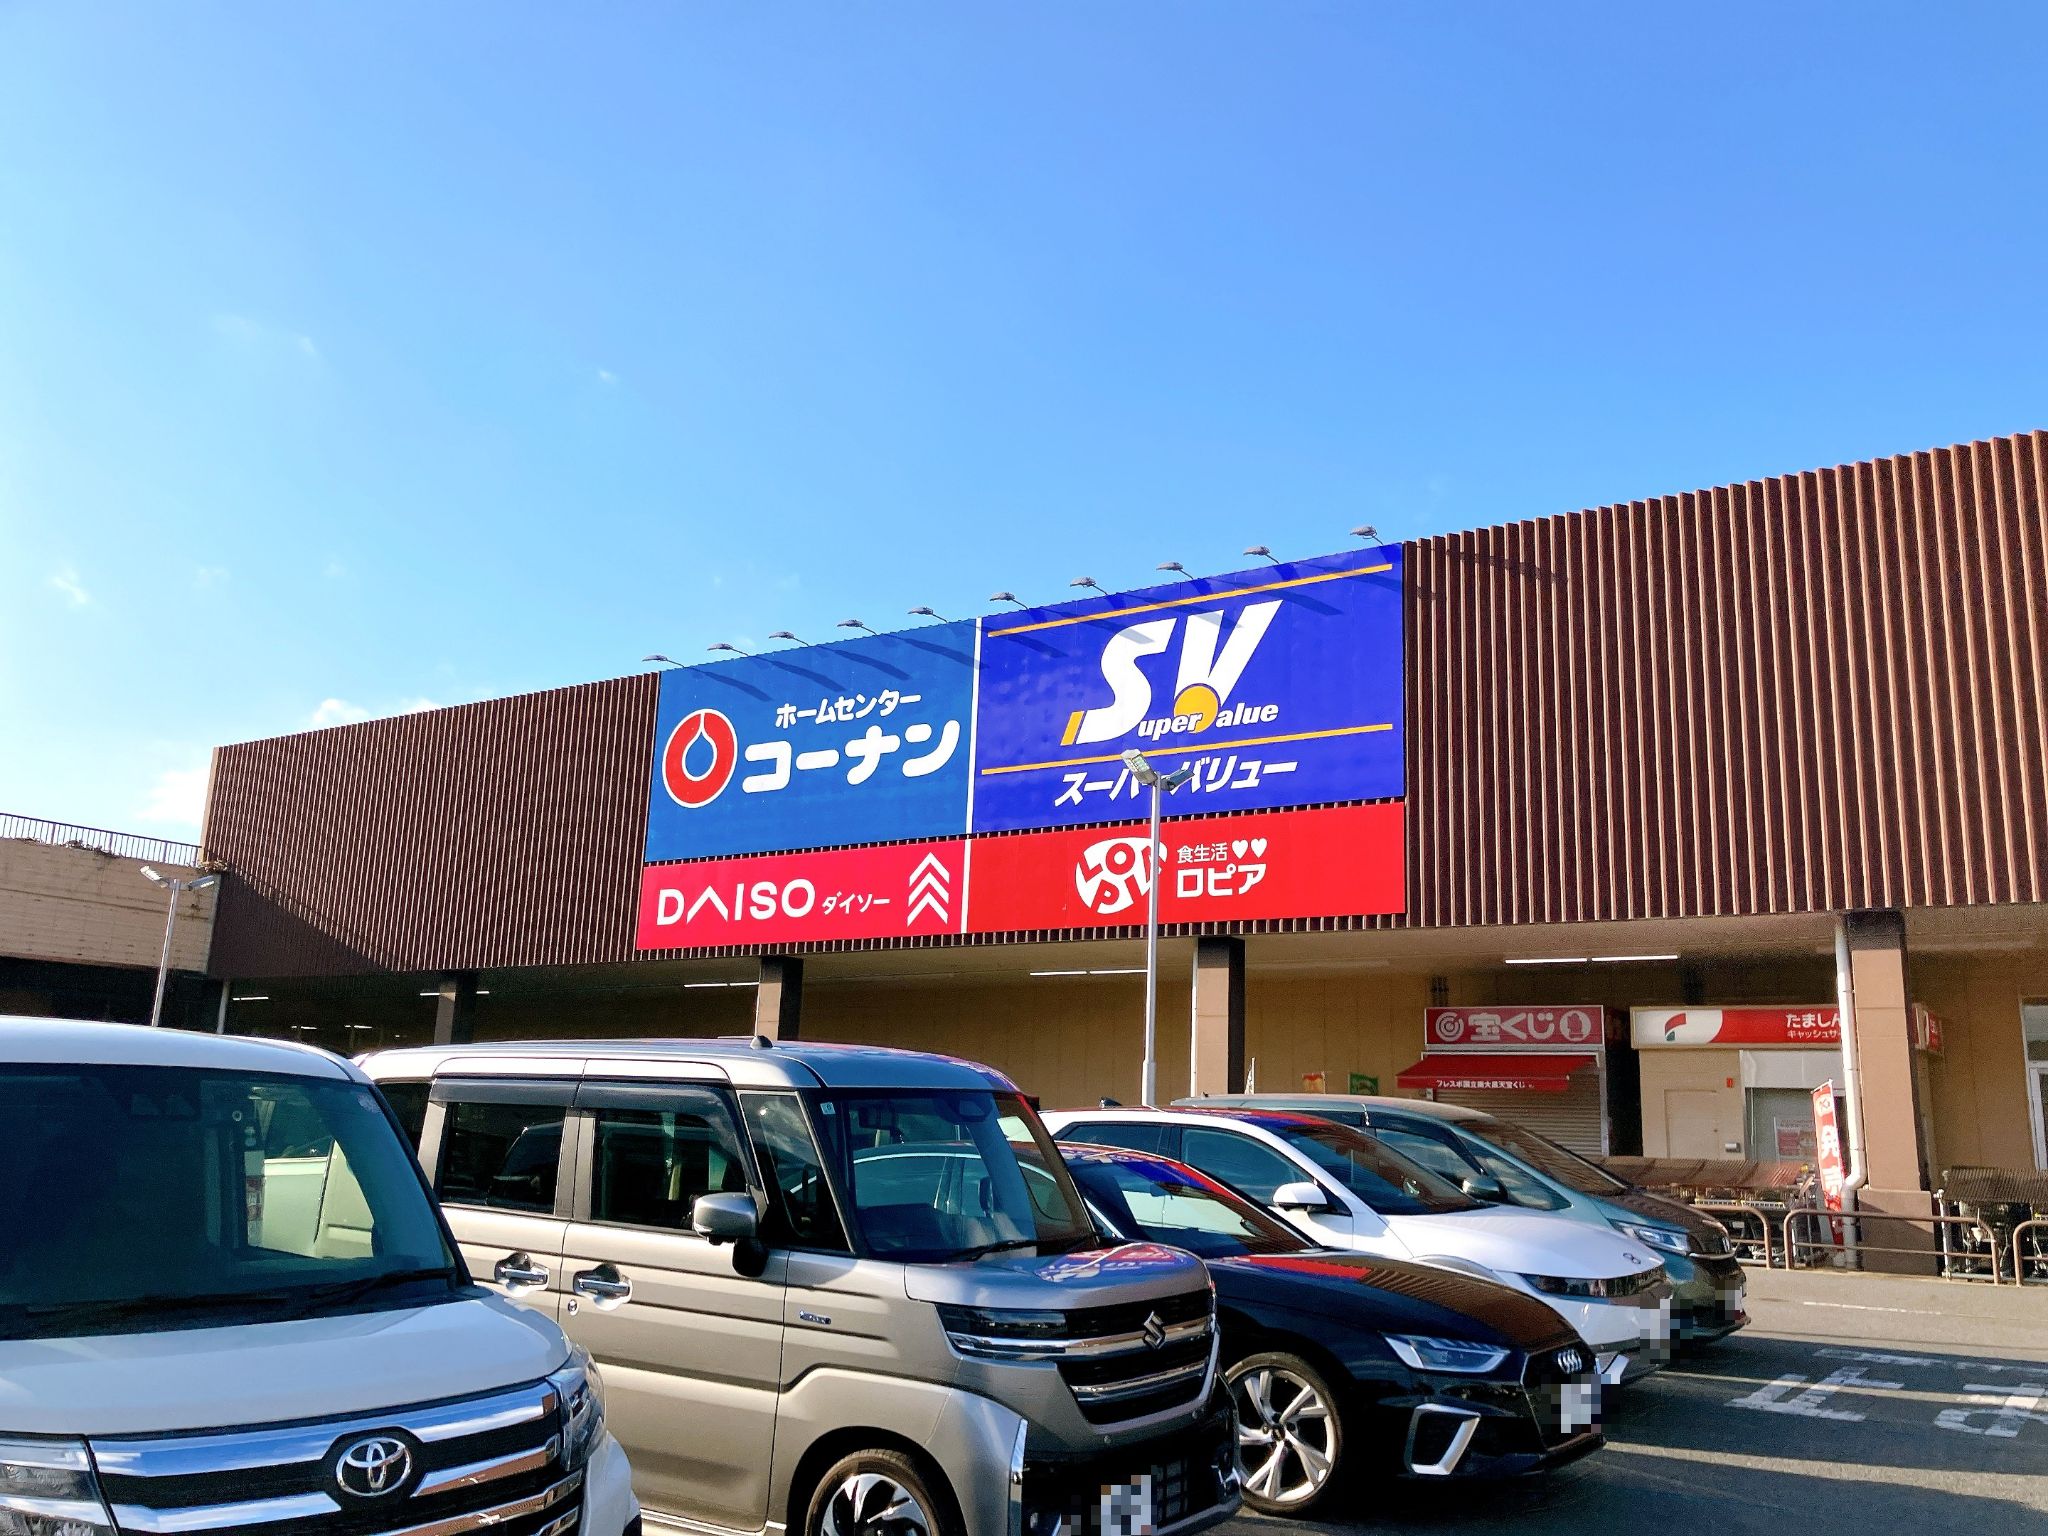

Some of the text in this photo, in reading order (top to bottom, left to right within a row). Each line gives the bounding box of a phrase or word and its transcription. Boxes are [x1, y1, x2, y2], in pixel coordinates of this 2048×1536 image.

[1076, 600, 1284, 744] SV
[775, 689, 922, 728] ホームセンター
[742, 719, 960, 793] コーナン
[1177, 842, 1228, 863] 食生活
[1177, 863, 1267, 898] ロピア
[656, 878, 816, 926] DAISO
[822, 891, 890, 915] ダイソー
[1468, 1012, 1555, 1040] 宝くじ
[1787, 1029, 1842, 1039] キャッシュサ
